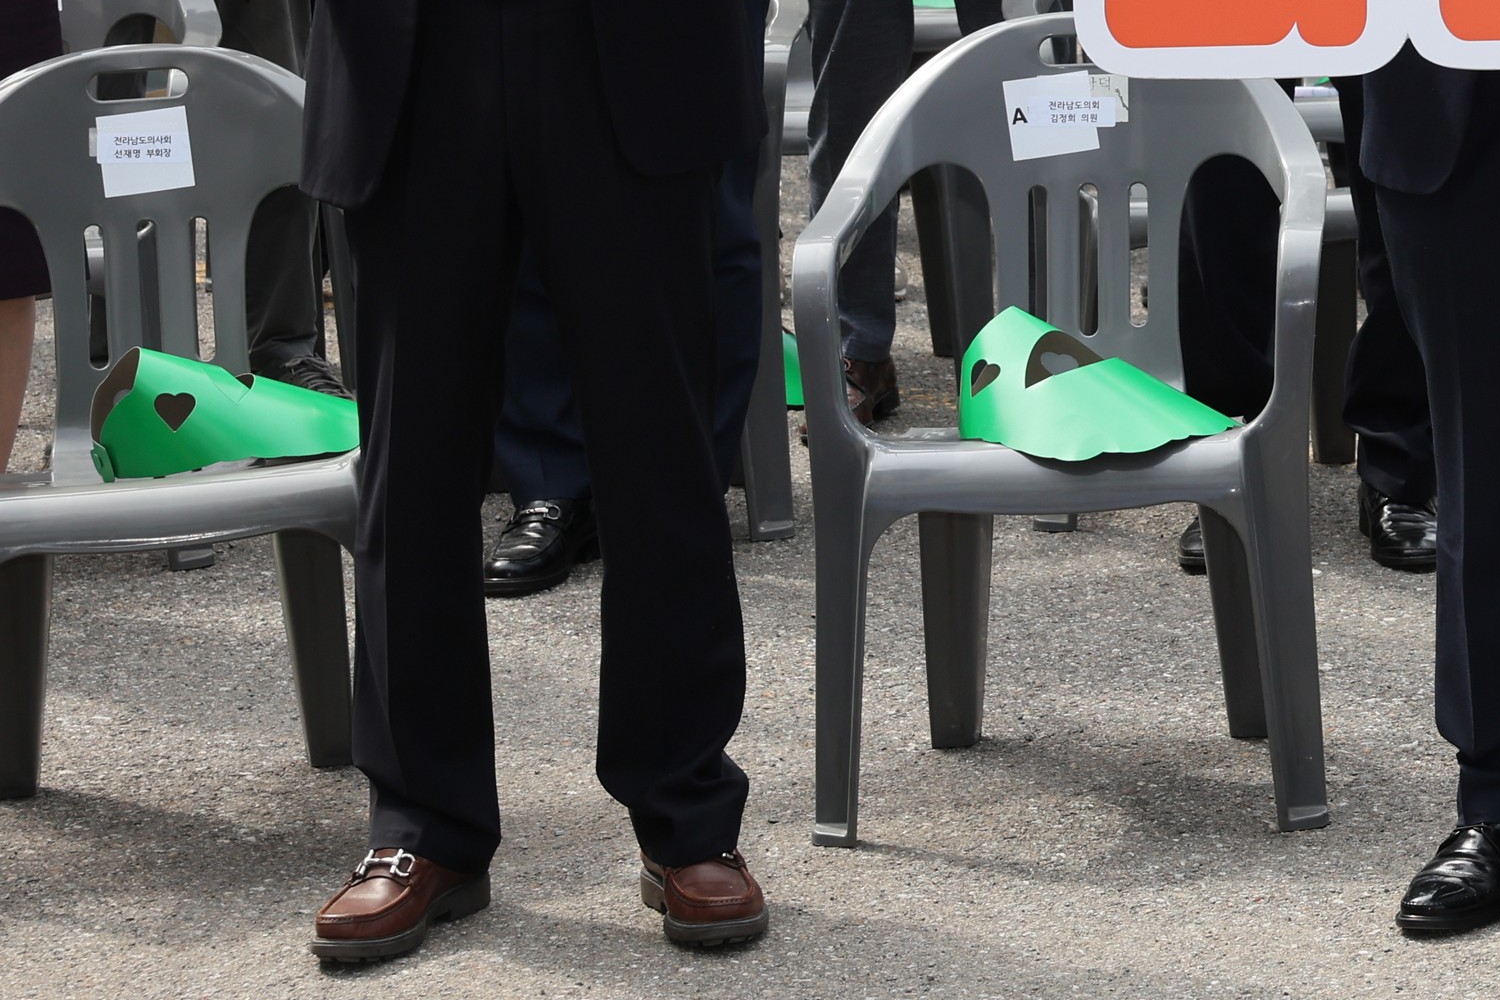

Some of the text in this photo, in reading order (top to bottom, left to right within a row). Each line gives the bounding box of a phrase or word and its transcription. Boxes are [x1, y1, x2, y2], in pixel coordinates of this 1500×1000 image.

[1048, 101, 1100, 110] 전라남도의회
[1012, 107, 1028, 125] A
[1081, 113, 1098, 123] 의원
[113, 135, 172, 146] 전라남도의사회
[146, 148, 172, 159] 부회장
